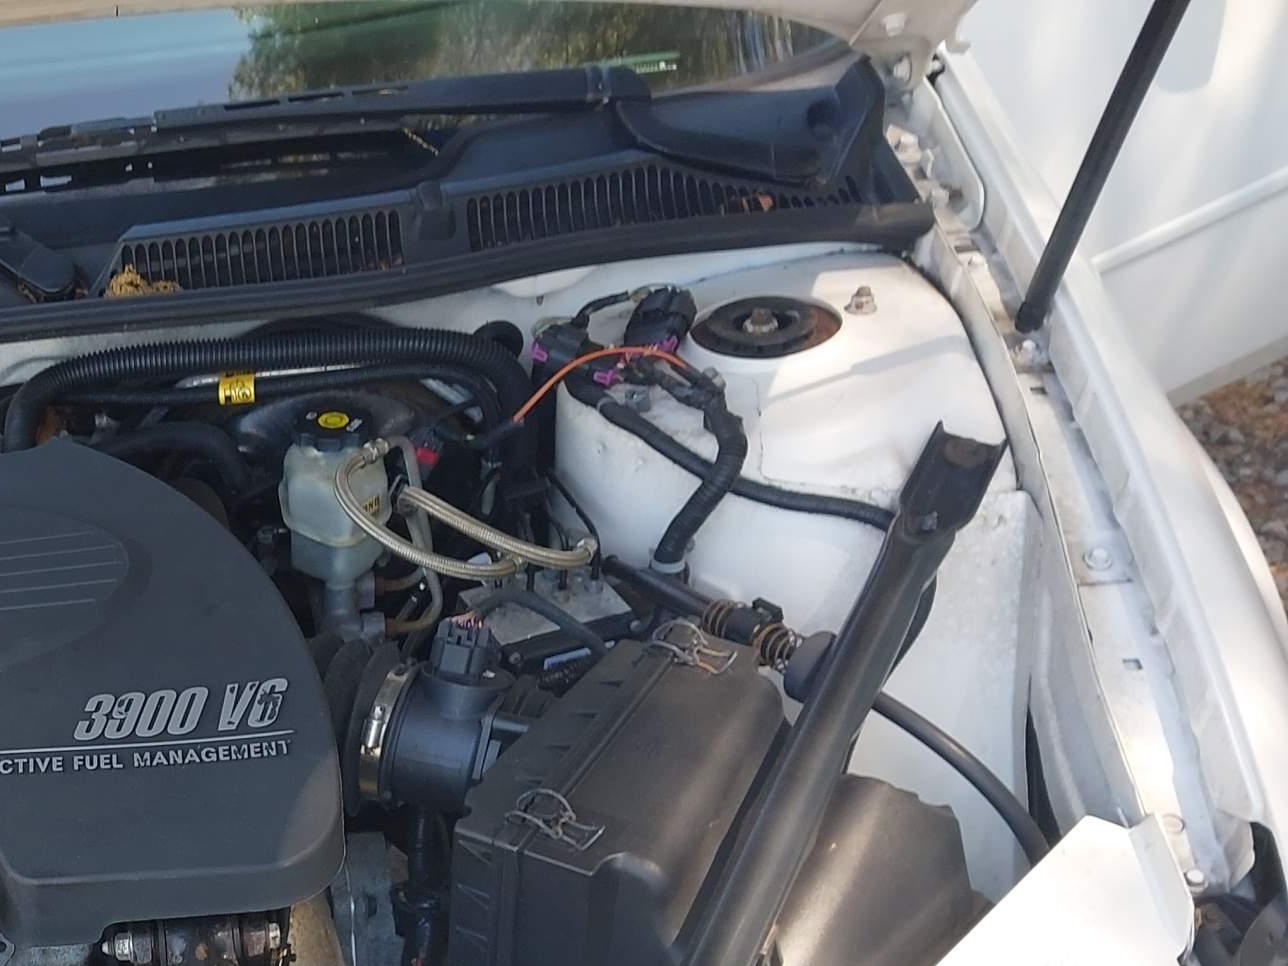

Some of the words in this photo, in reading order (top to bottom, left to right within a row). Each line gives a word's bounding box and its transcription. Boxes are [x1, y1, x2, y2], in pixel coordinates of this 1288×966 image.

[73, 686, 209, 740] 3900
[217, 678, 288, 731] V6
[73, 753, 124, 770] FUEL
[133, 741, 289, 767] MANAGEMENT
